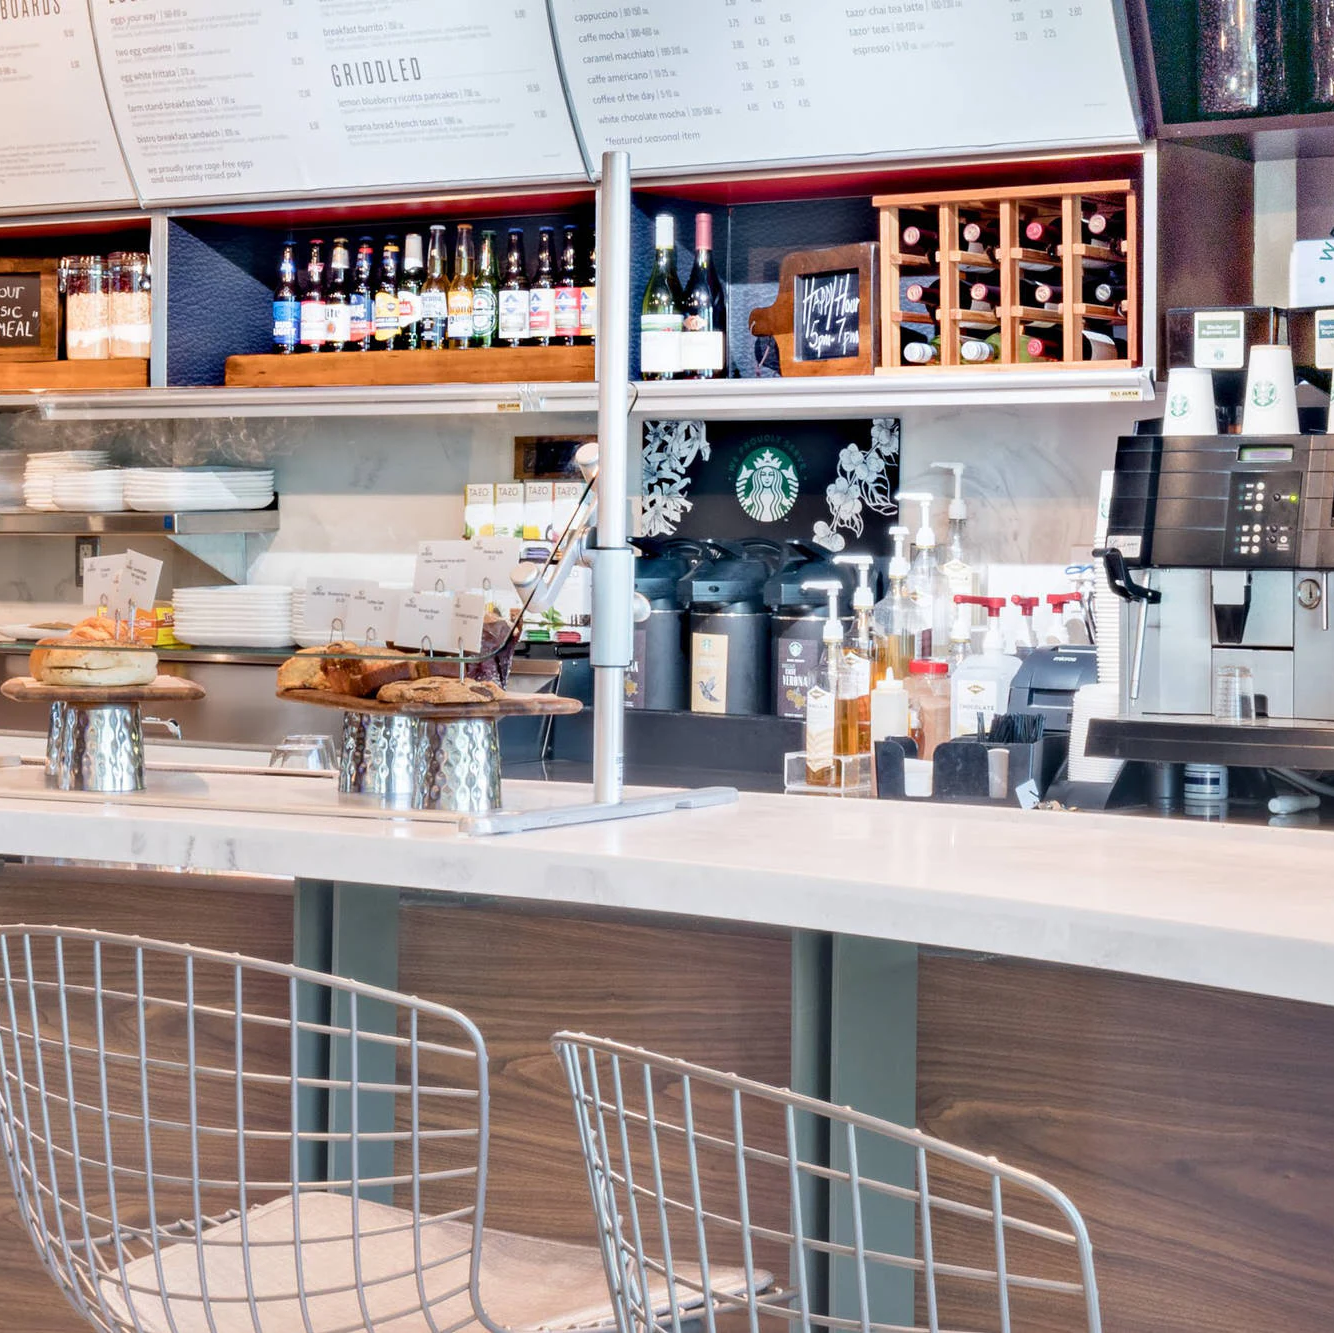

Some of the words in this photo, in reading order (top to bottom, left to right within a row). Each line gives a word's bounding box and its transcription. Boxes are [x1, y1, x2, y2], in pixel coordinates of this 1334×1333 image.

[1, 0, 61, 20] BOARDS
[574, 10, 619, 23] cappuccino
[868, 6, 887, 17] chai
[888, 4, 902, 14] tea
[903, 1, 925, 14] latte
[322, 24, 357, 37] breakfast
[358, 22, 384, 34] burrito
[598, 30, 625, 41] mocha
[872, 24, 891, 35] teas
[582, 52, 614, 65] caramel
[615, 48, 655, 62] macchiato
[852, 43, 891, 56] espresso
[331, 57, 422, 88] GRIDDLED
[607, 71, 648, 84] americano
[361, 93, 397, 106] blueberry
[398, 91, 422, 103] ricotta
[423, 89, 460, 102] pancakes
[593, 94, 616, 105] coffee
[617, 93, 625, 103] of
[625, 92, 640, 102] the
[640, 90, 655, 102] day
[345, 121, 372, 132] banana
[373, 118, 394, 130] bread
[394, 116, 419, 129] french
[419, 116, 439, 127] toast
[597, 114, 620, 125] white
[620, 110, 658, 123] chocolate
[658, 108, 686, 120] mocha
[189, 128, 221, 139] sandwich
[644, 132, 680, 145] seasonal
[681, 129, 701, 141] item
[159, 163, 183, 175] proudly
[185, 163, 203, 171] serve
